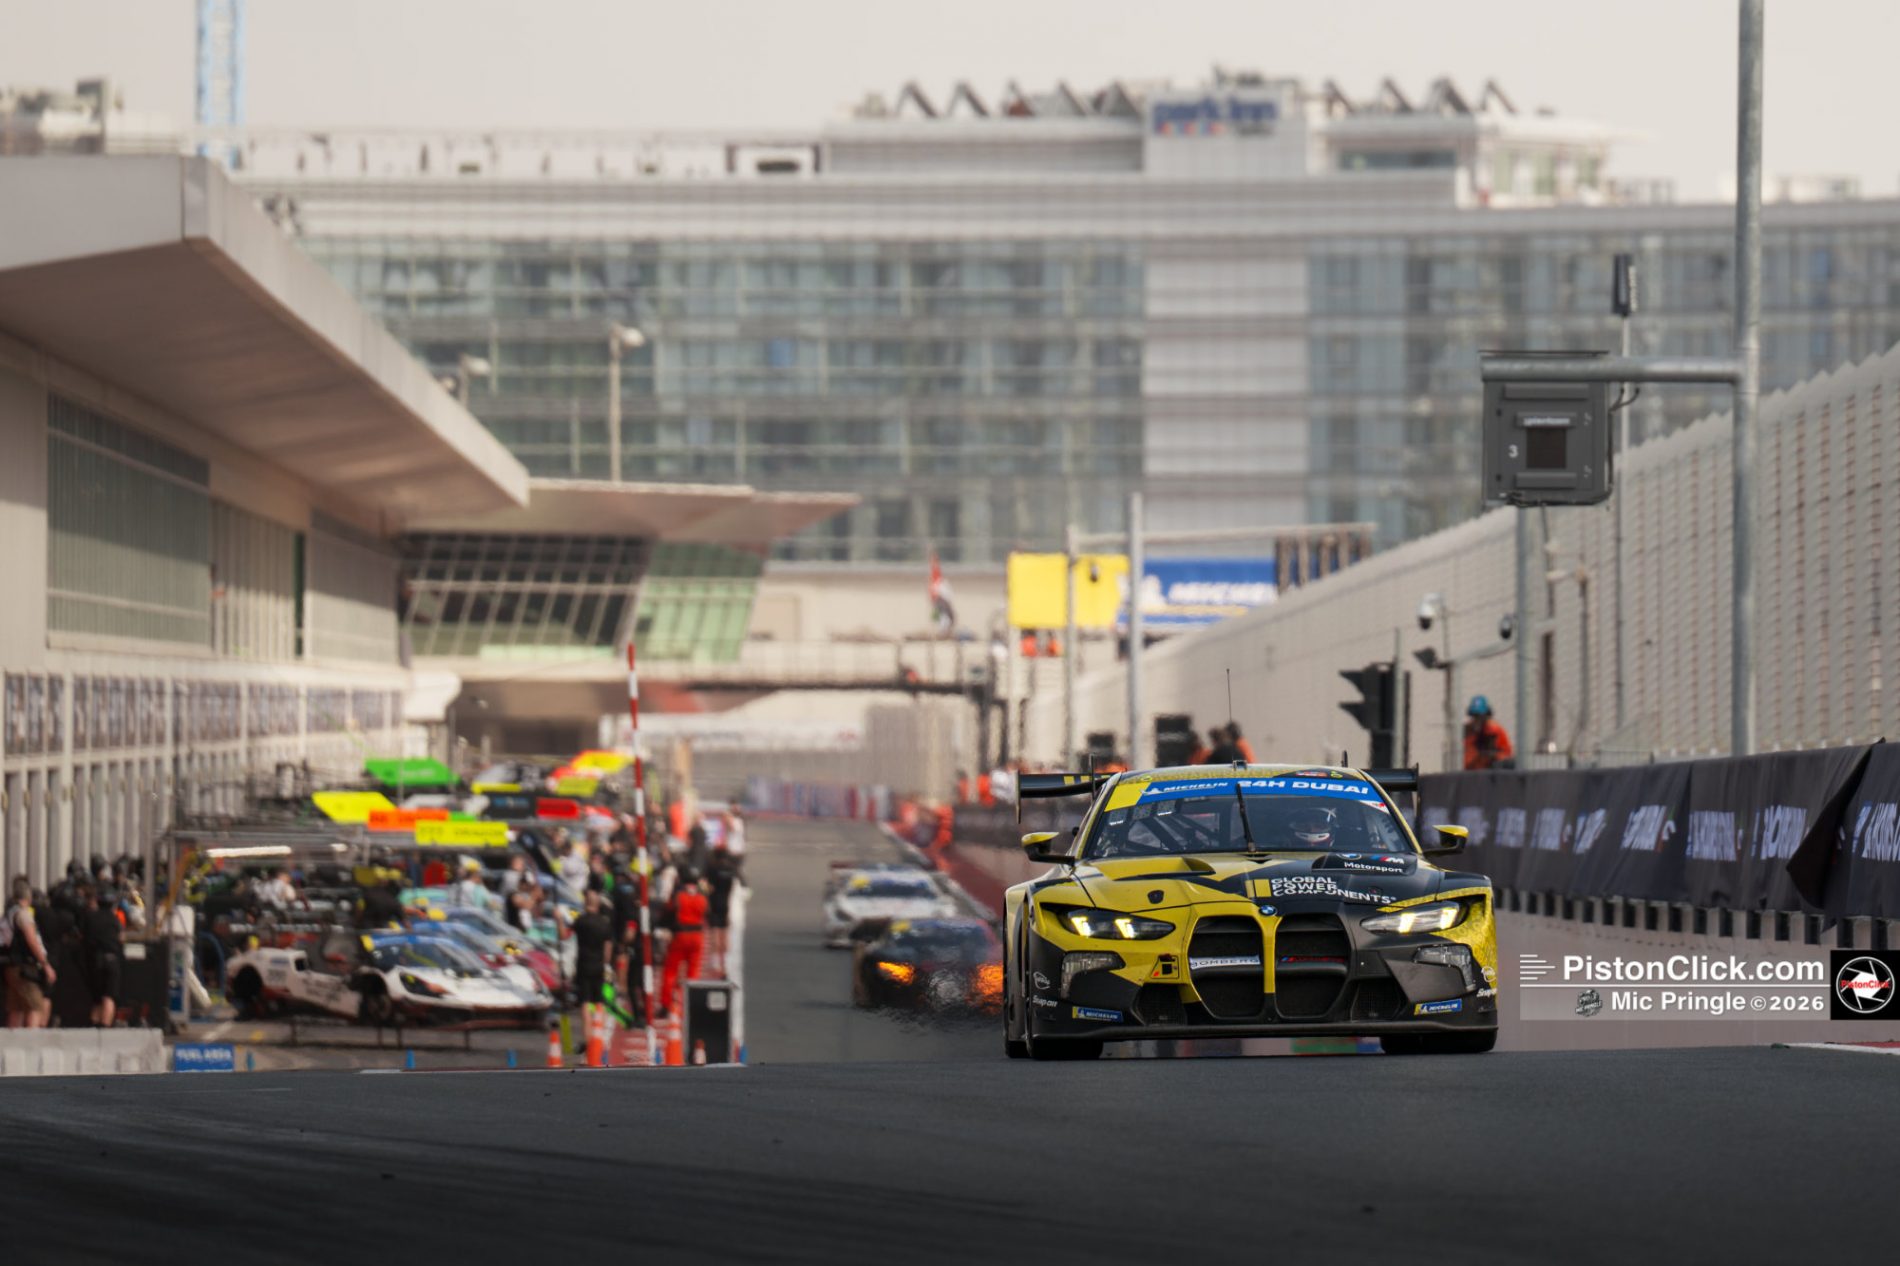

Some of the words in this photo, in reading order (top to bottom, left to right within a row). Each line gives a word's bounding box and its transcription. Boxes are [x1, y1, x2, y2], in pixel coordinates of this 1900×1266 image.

[1508, 444, 1518, 458] 3
[1164, 782, 1229, 792] MICHELIN
[1237, 780, 1286, 788] 24H
[1292, 781, 1369, 794] DUBAI
[1344, 861, 1403, 873] Motorsport
[1271, 876, 1337, 884] GLOBAL
